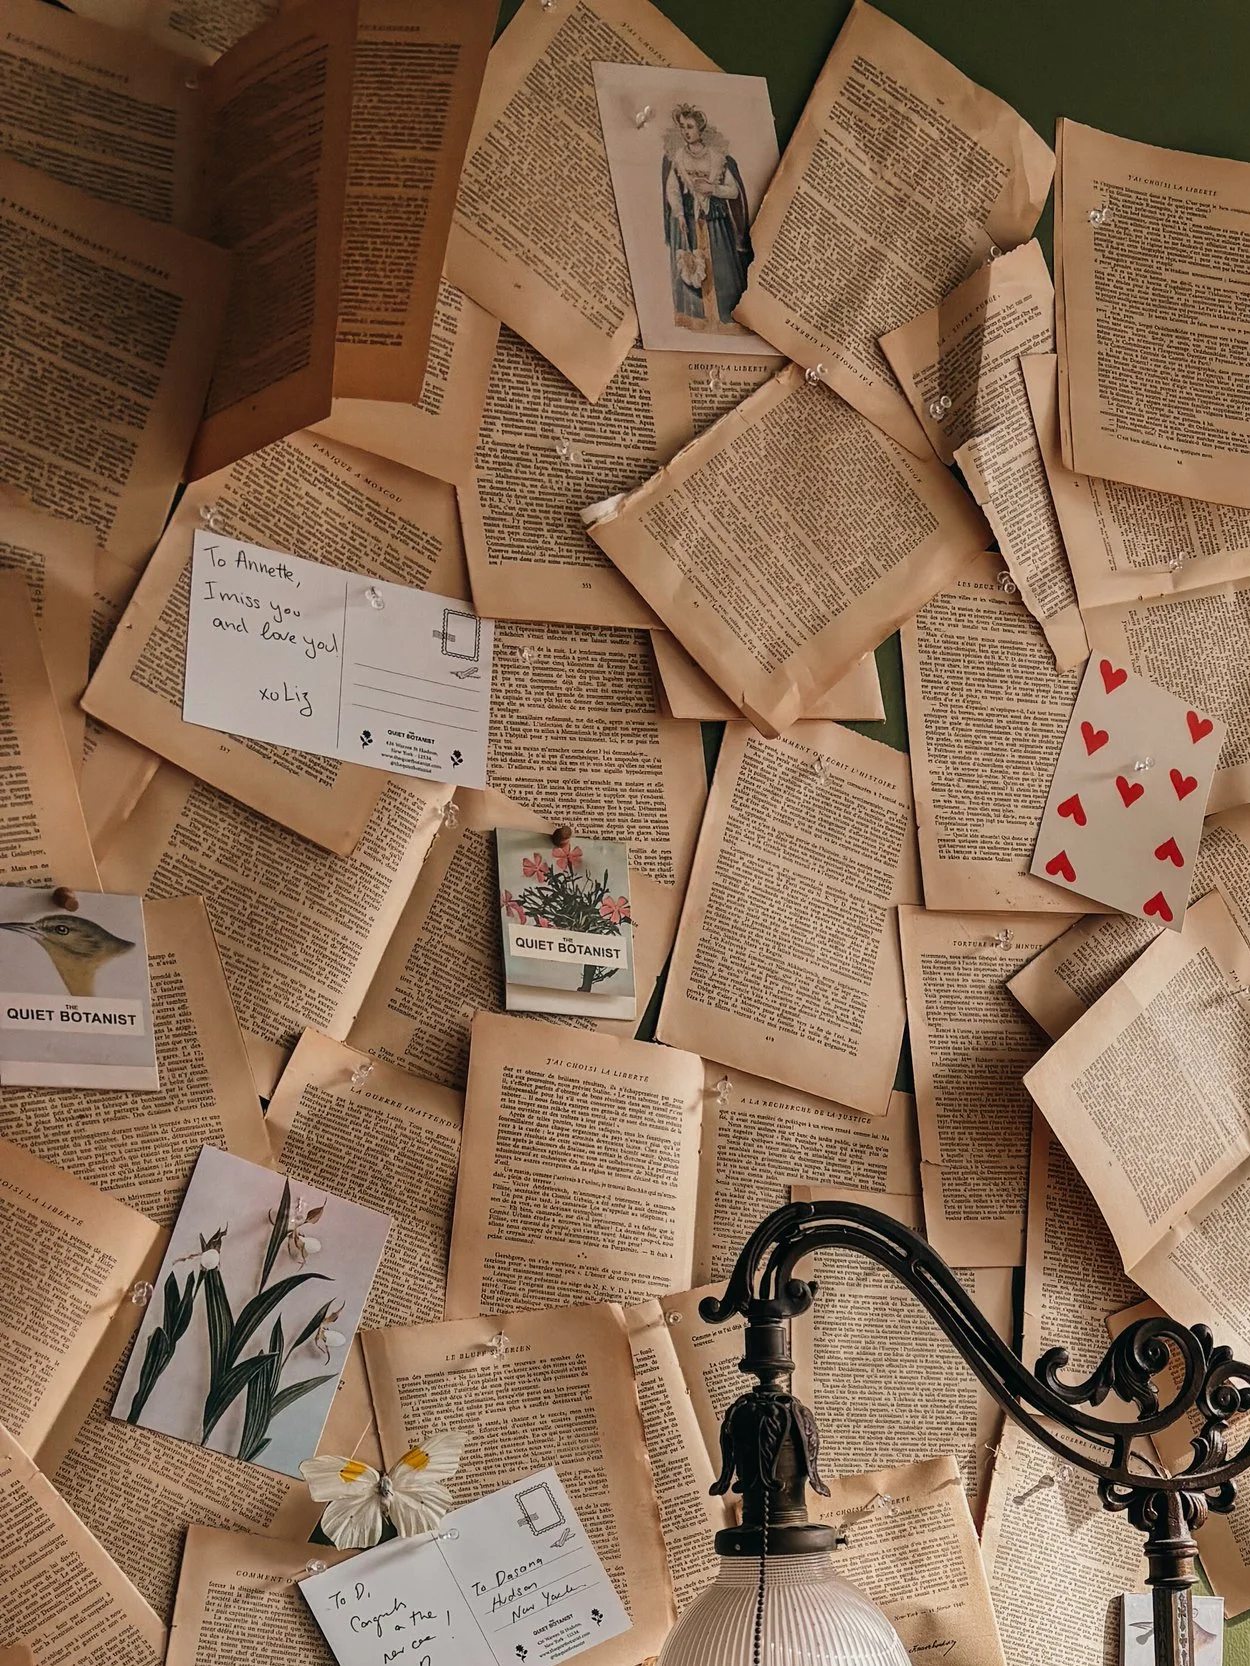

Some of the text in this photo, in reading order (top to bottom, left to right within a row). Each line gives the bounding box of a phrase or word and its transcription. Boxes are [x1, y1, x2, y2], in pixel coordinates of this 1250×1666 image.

[1127, 174, 1141, 182] J'AI
[1144, 177, 1170, 188] CHOISI
[819, 342, 831, 352] LA
[829, 350, 860, 374] CHOISI
[311, 442, 353, 473] PANIQUE
[363, 476, 403, 505] MOSCOU
[204, 546, 226, 568] To
[219, 592, 260, 609] miss
[270, 600, 301, 623] you
[212, 617, 249, 633] and
[260, 622, 297, 644] love
[775, 734, 809, 753] OMMENT
[515, 937, 621, 959] QUIET BOTANIST
[7, 1008, 136, 1025] QUIET BOTANIST
[546, 1058, 562, 1067] J'AI
[565, 1061, 596, 1072] CHOISI
[349, 1085, 362, 1094] LA
[364, 1091, 401, 1109] GUERRE
[762, 1101, 811, 1113] RECHERCHE
[837, 1113, 871, 1124] JUSTICE
[236, 1571, 283, 1582] COMMENT
[471, 1582, 487, 1596] To
[493, 1582, 538, 1613] Hudson
[329, 1591, 346, 1609] To
[409, 1611, 437, 1626] the
[512, 1604, 535, 1623] New
